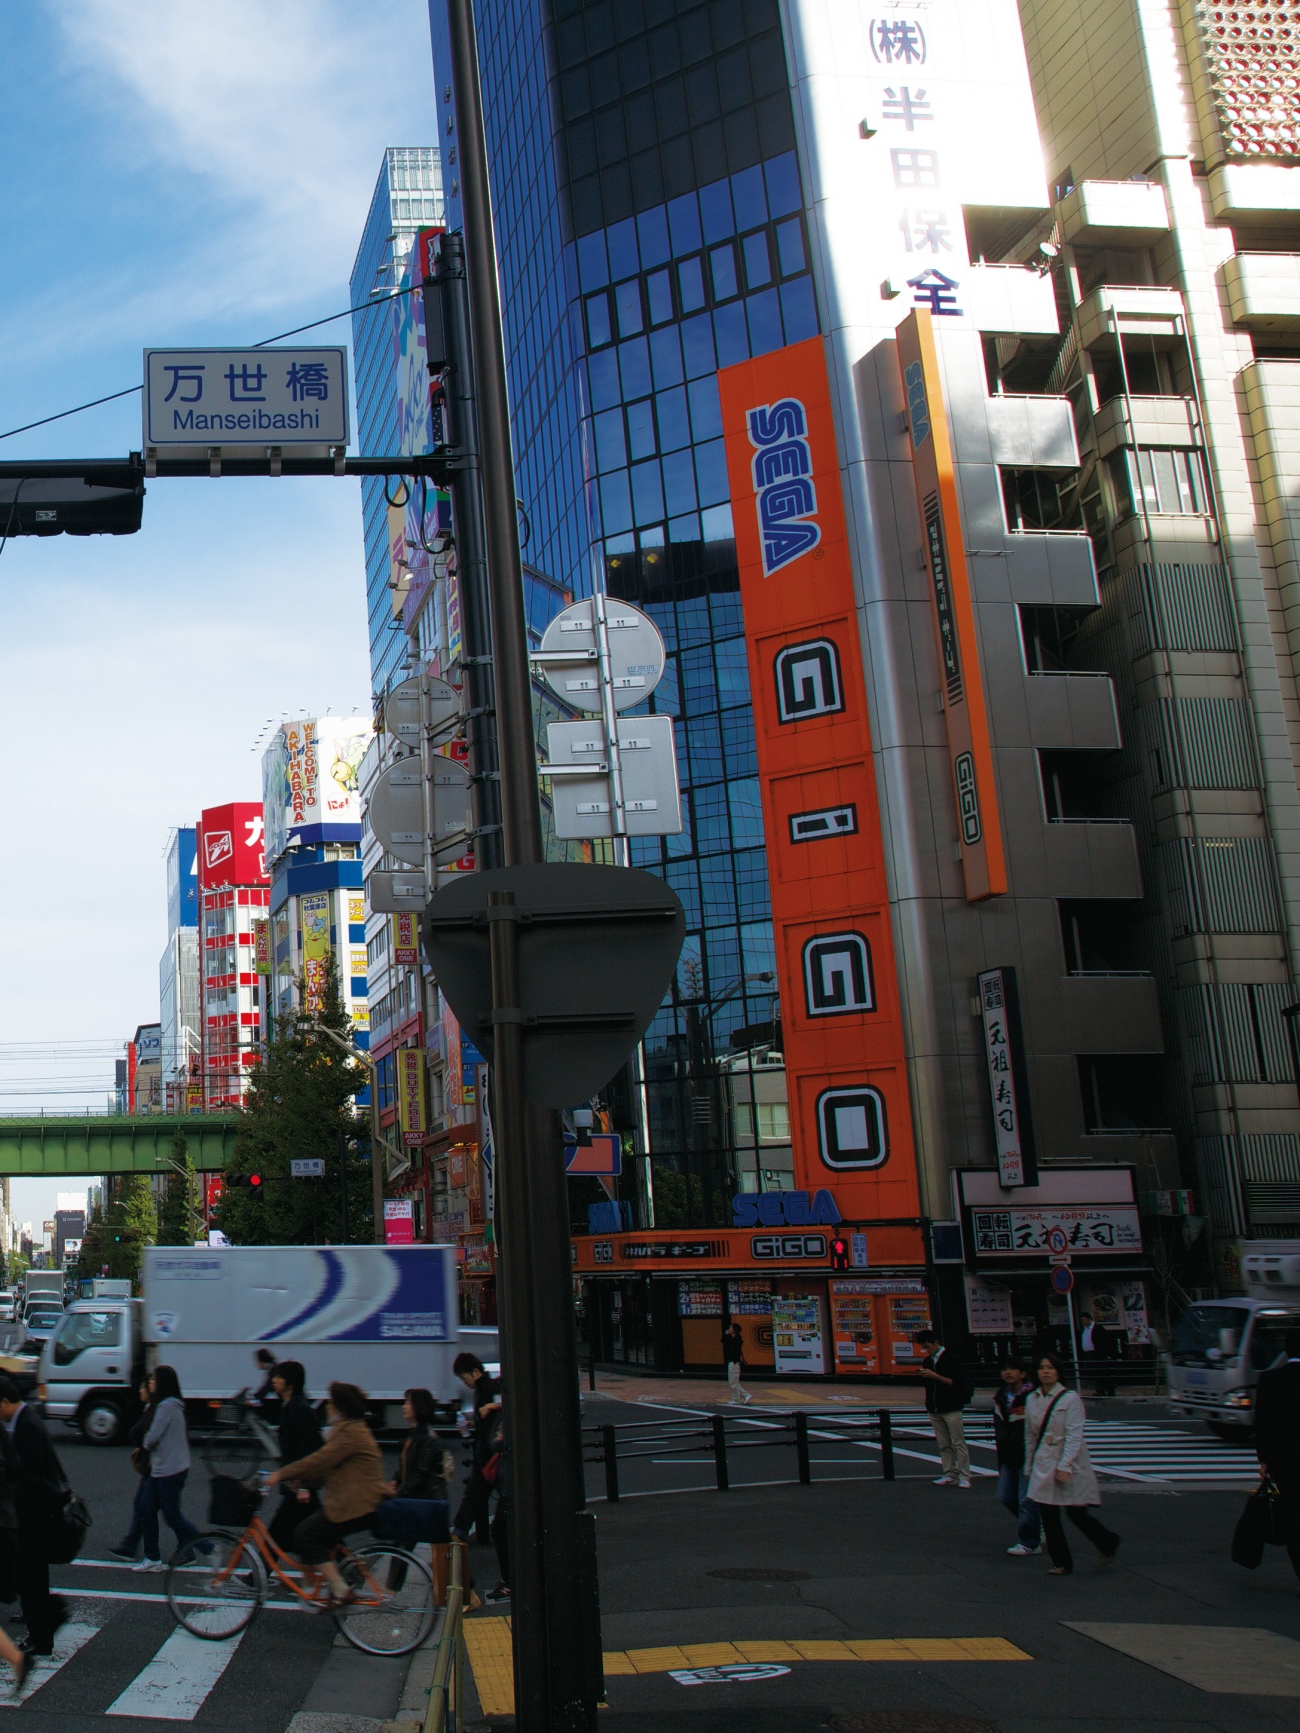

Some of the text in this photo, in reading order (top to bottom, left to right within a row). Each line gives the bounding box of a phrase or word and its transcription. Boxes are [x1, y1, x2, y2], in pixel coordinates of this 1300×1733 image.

[163, 362, 330, 402] 万世橋
[903, 359, 930, 453] SEGA
[173, 409, 321, 430] Manseibashi
[745, 397, 822, 579] SEGA
[288, 730, 306, 823] AKIHABARA
[303, 723, 317, 807] WELCOME TO
[406, 1052, 421, 1131] 免税 DUTY FREE
[988, 1020, 1015, 1133] 元祖寿司
[294, 1161, 320, 1170] 万世橋
[731, 1189, 842, 1227] SEGA
[977, 1214, 1009, 1231] 回転
[979, 1232, 1011, 1249] 寿司
